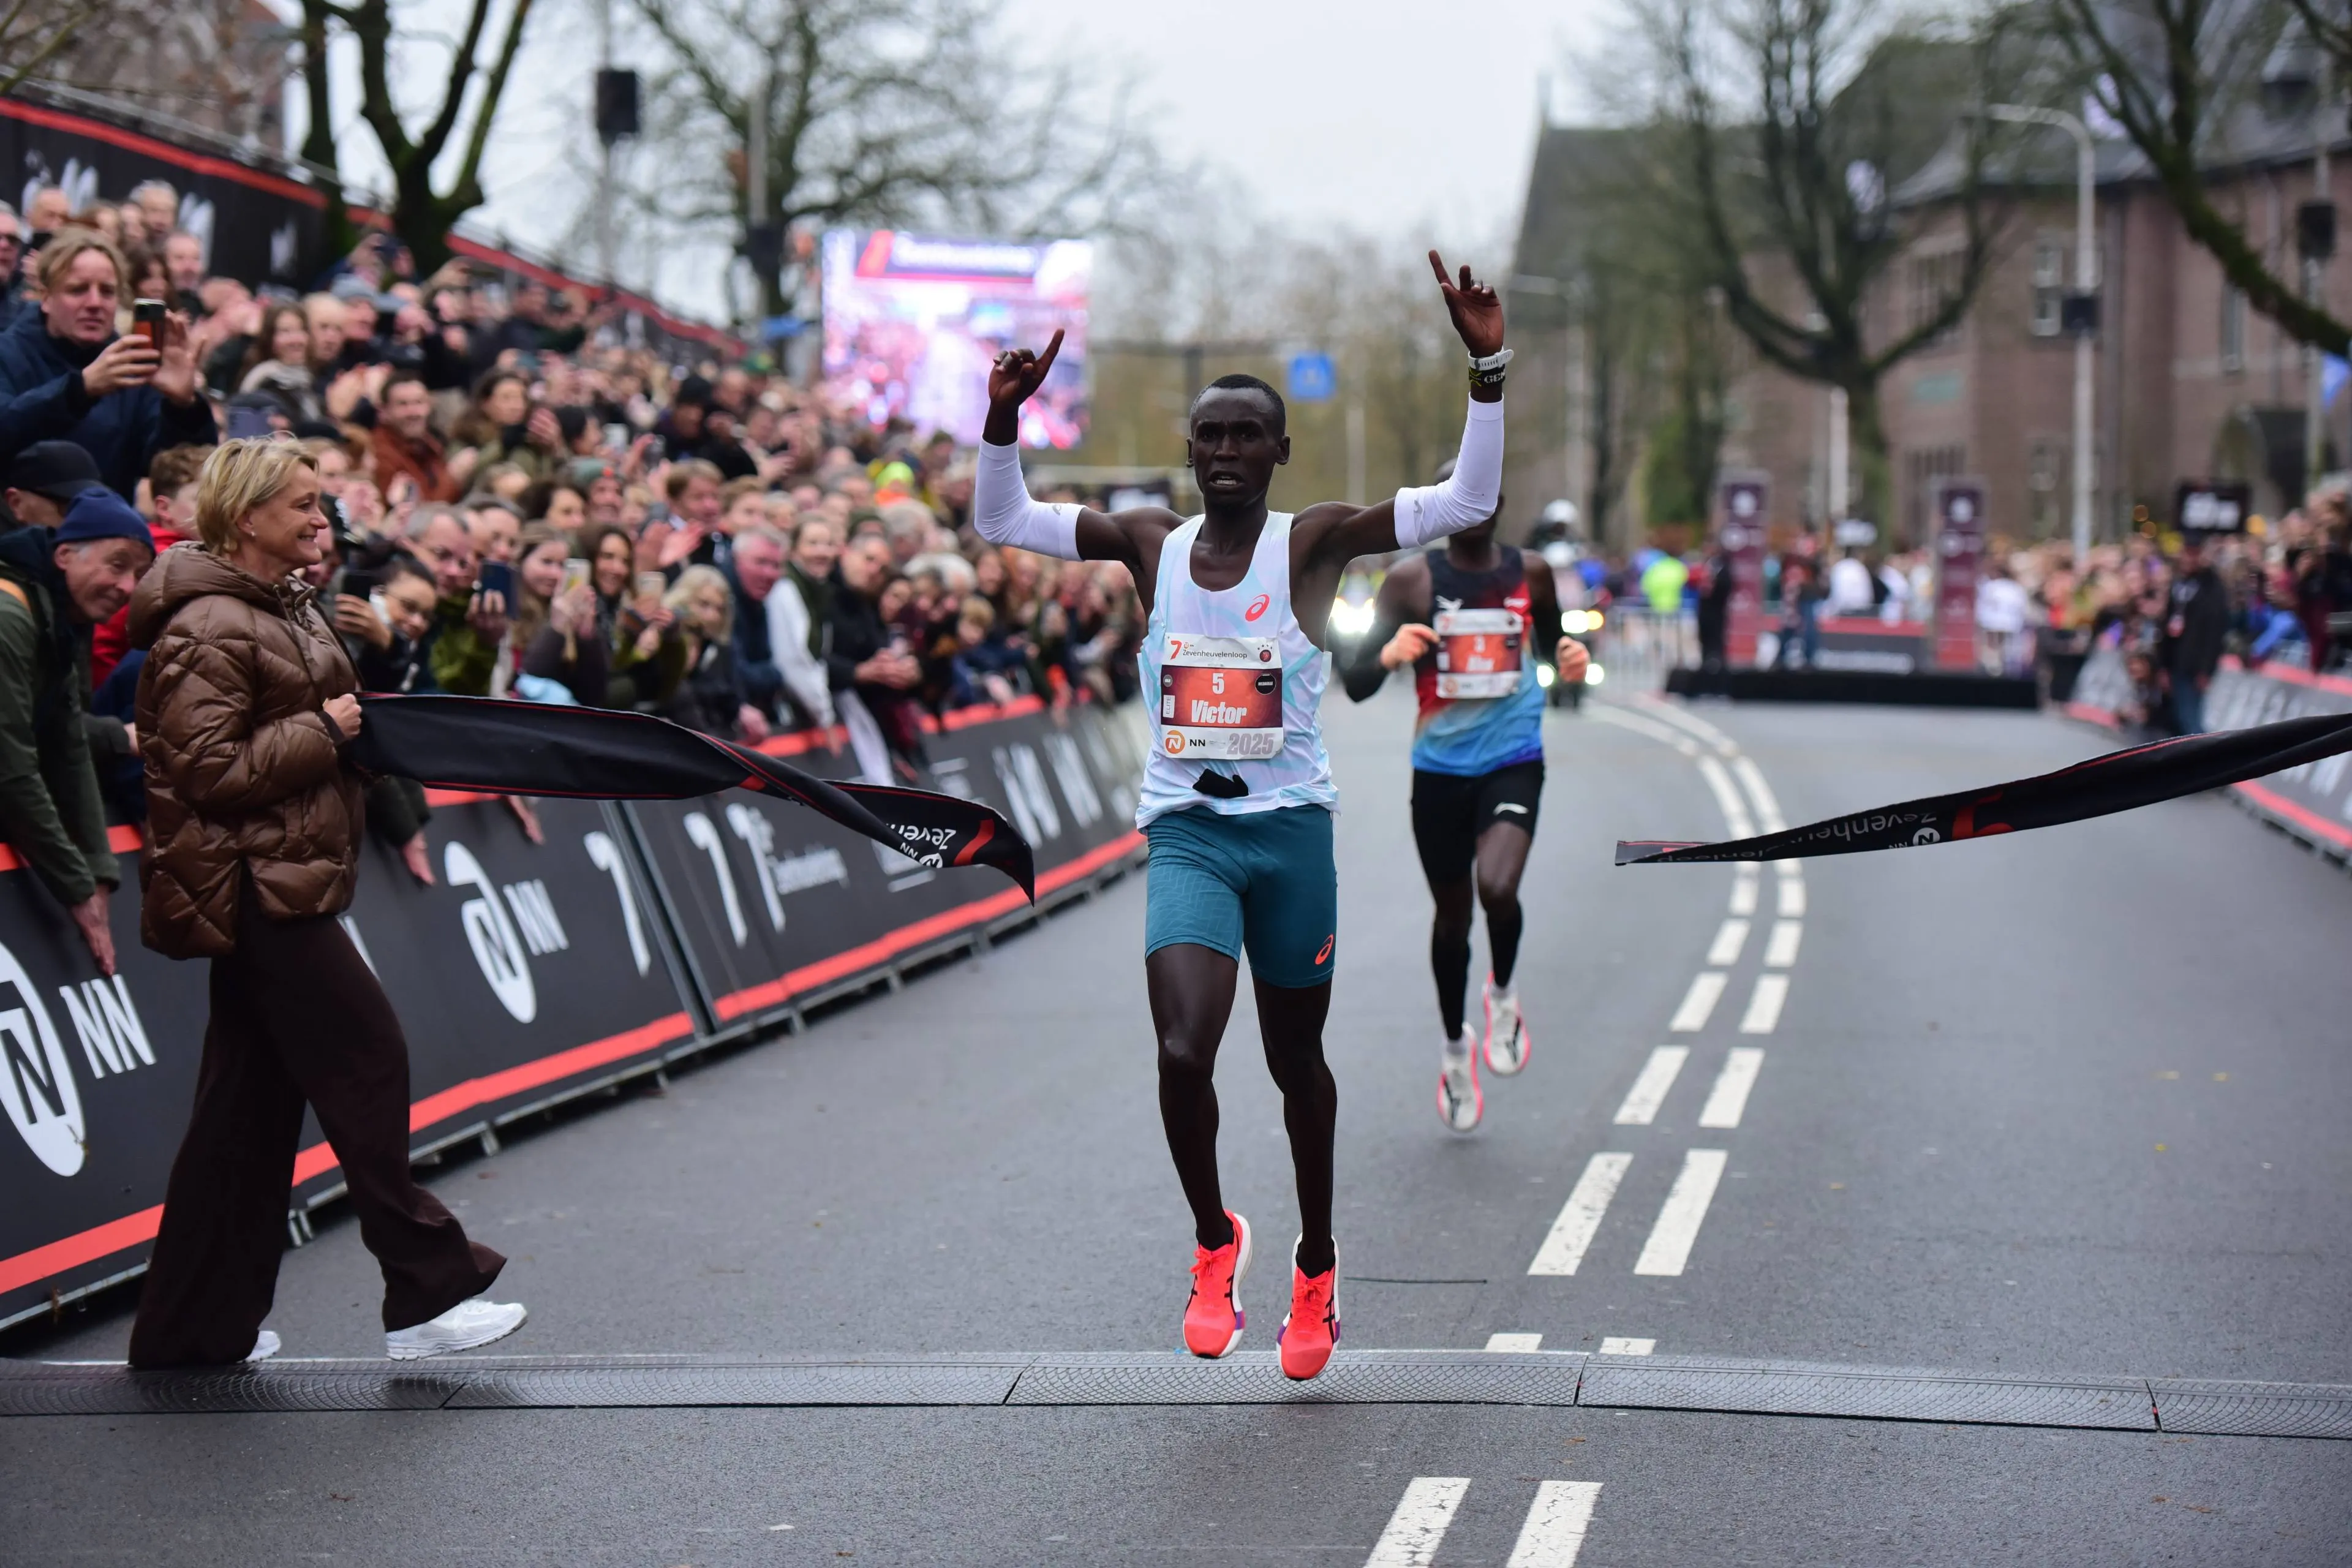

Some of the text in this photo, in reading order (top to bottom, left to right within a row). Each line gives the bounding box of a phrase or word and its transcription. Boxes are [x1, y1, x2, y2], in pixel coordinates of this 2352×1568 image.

[1170, 640, 1182, 660] 7
[1183, 649, 1248, 660] Zevenheuvelenloop
[1212, 673, 1224, 695] 5
[1191, 699, 1248, 725] Victor
[1226, 733, 1275, 756] 2025
[900, 842, 919, 859] NN
[59, 973, 157, 1080] NN
